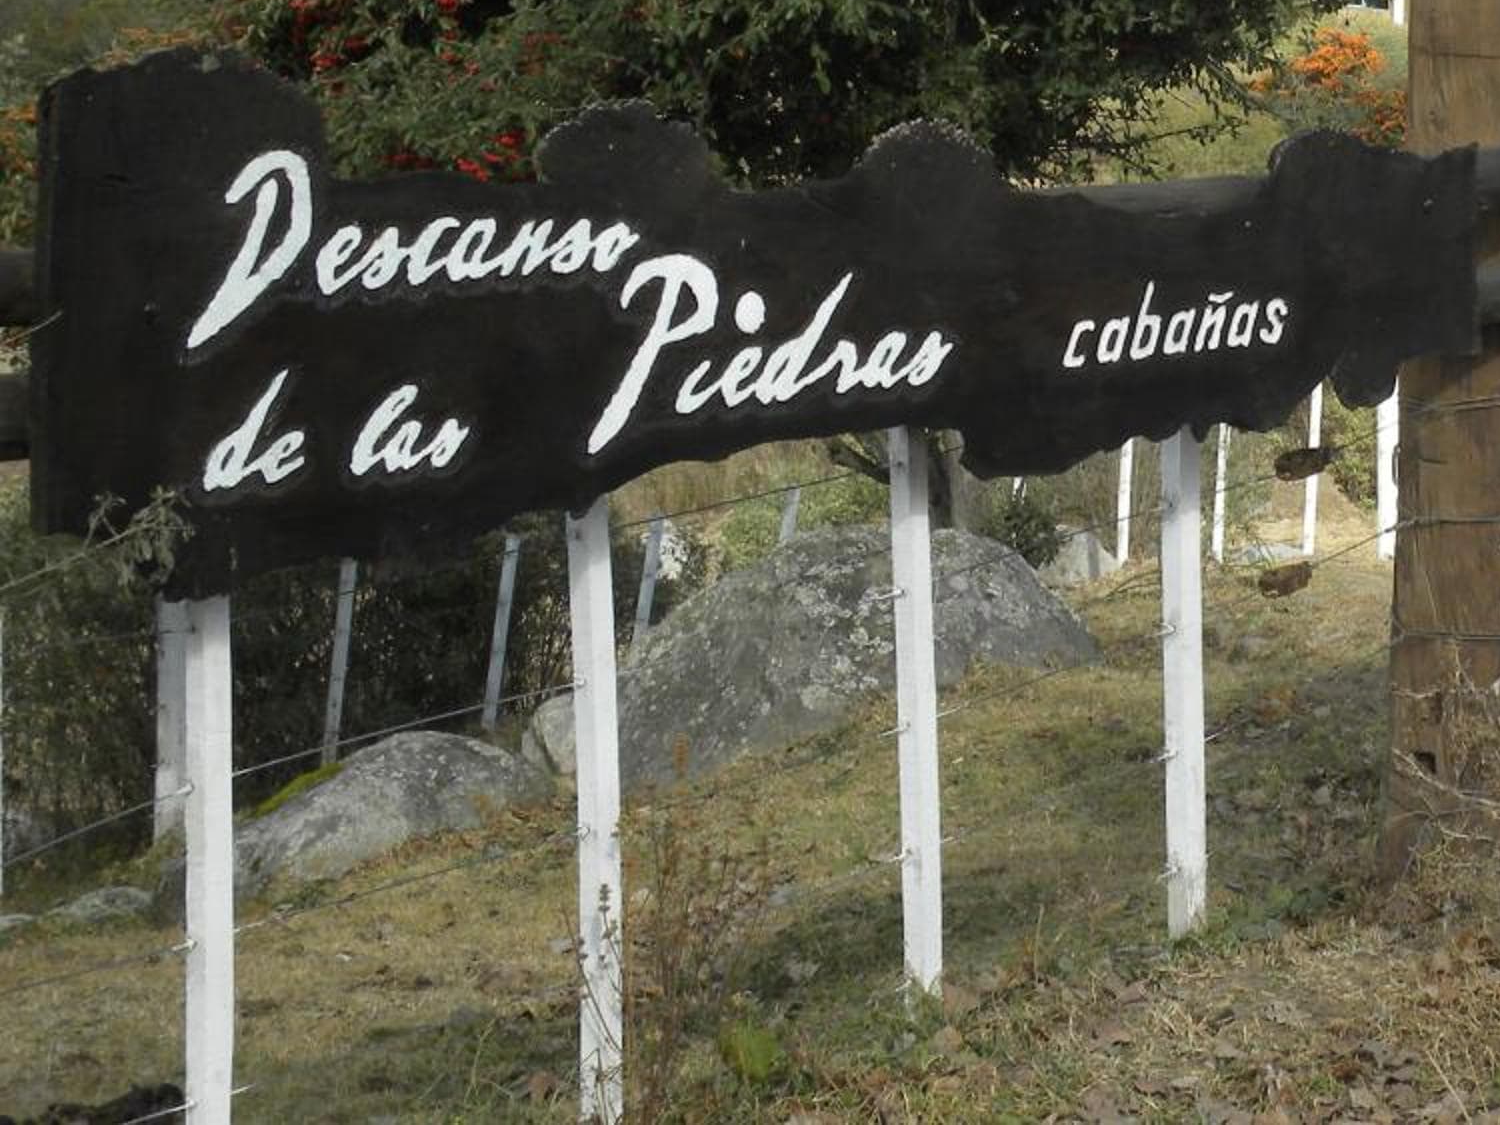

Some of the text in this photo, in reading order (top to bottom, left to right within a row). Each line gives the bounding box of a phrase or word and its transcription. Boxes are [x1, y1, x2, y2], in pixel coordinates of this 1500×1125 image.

[187, 150, 640, 349] Descanso
[1062, 280, 1289, 369] cabañas
[203, 253, 954, 492] de las Piedras
